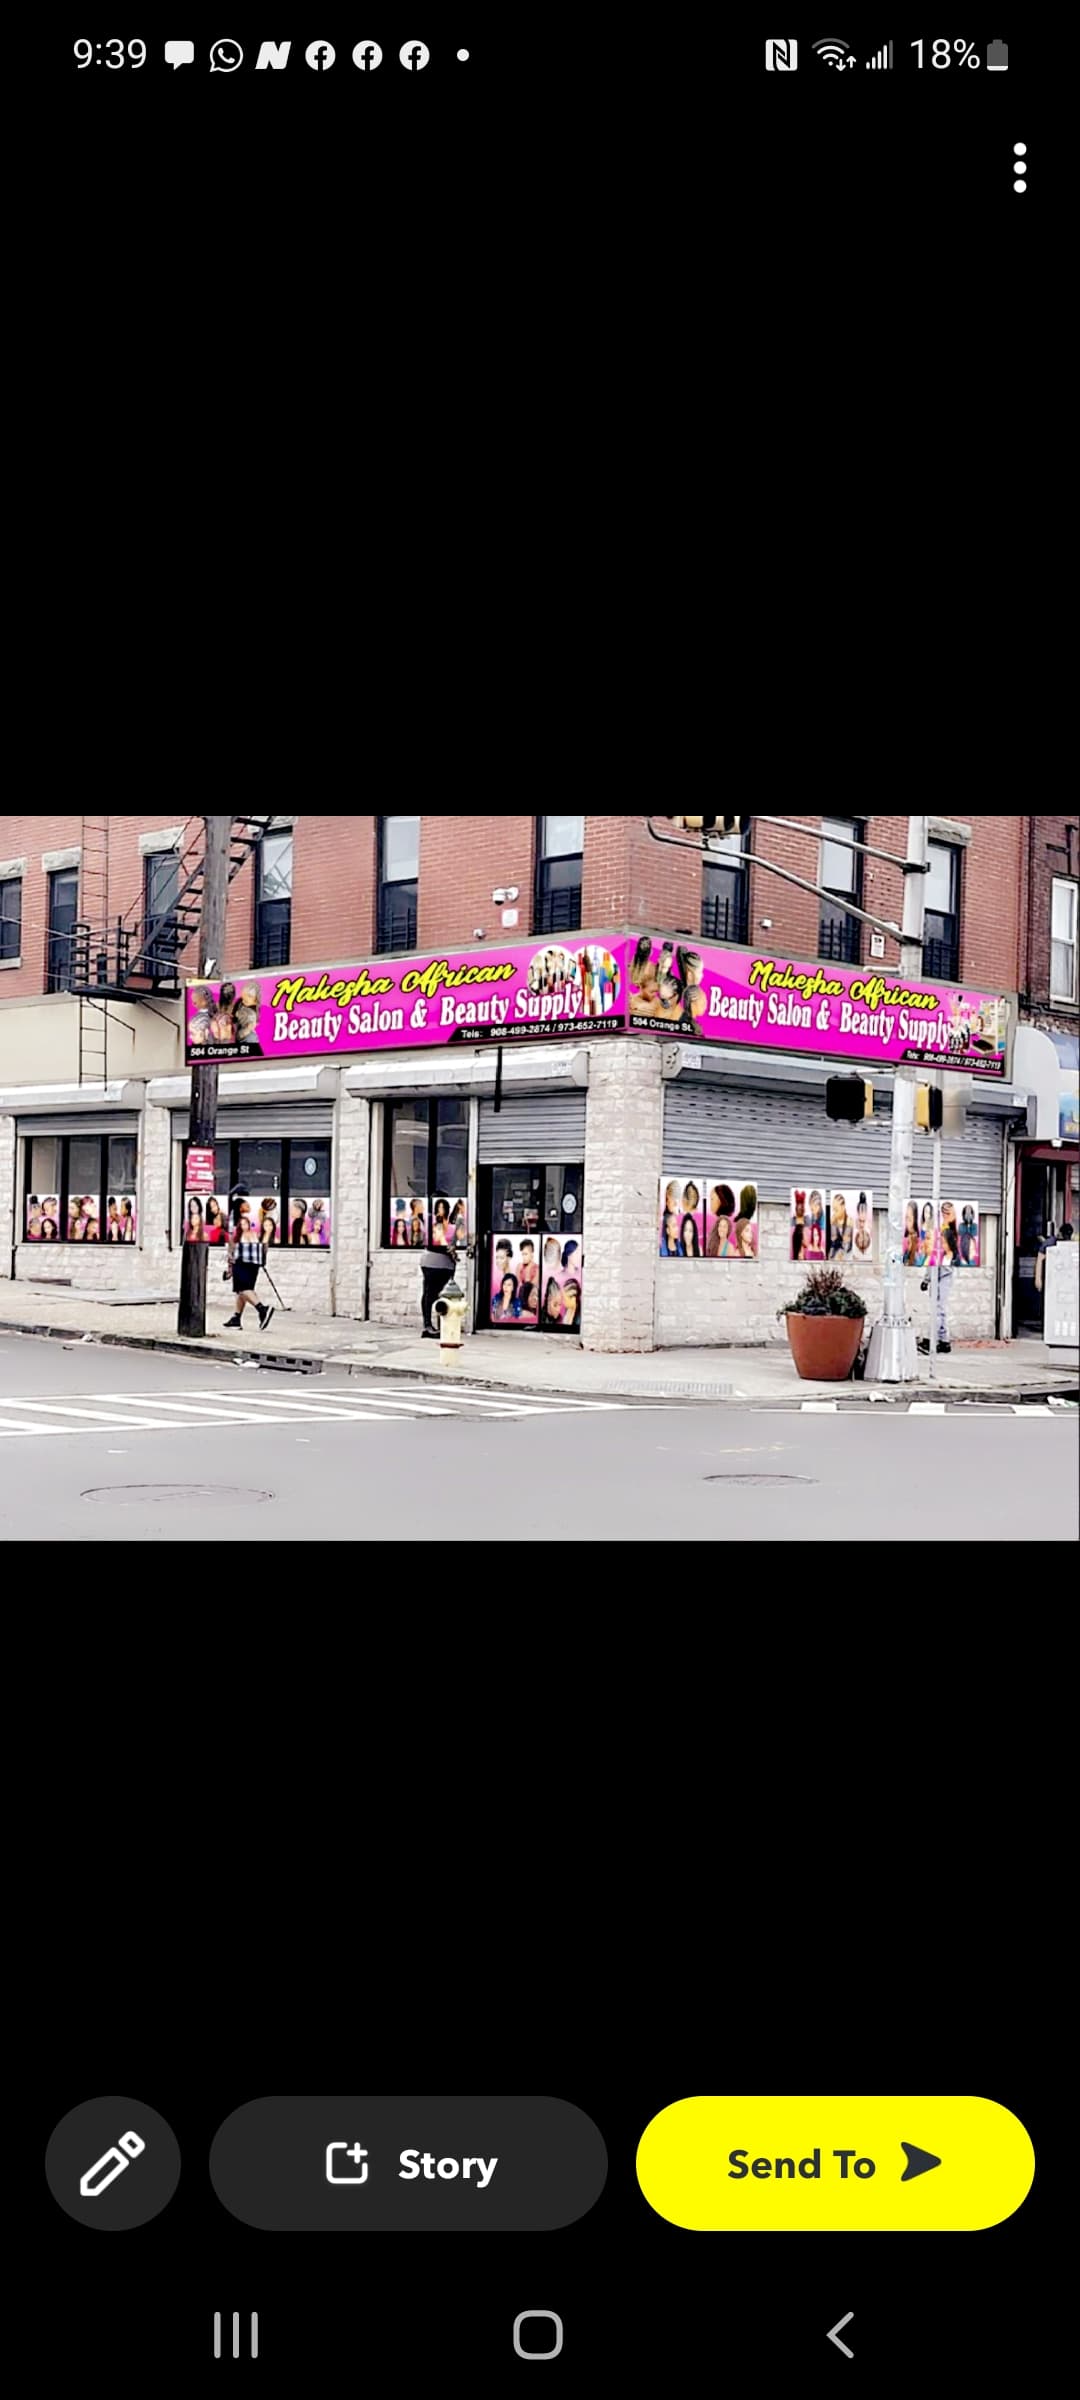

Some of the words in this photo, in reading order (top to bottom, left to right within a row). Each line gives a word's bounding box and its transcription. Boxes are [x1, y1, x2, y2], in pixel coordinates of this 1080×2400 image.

[401, 960, 517, 998] African
[849, 975, 940, 1010] African
[273, 1010, 342, 1043] Beauty
[348, 1001, 404, 1035] Salon
[410, 998, 428, 1029] &
[439, 994, 509, 1025] Beauty
[514, 982, 583, 1021] Supply
[649, 1018, 680, 1031] Orange
[708, 986, 764, 1029] Beauty
[767, 993, 812, 1028] Salon
[816, 999, 831, 1030] &
[839, 1002, 895, 1045] Beauty
[898, 1009, 951, 1051] Supply
[207, 1046, 239, 1056] Orange
[240, 1045, 250, 1054] St
